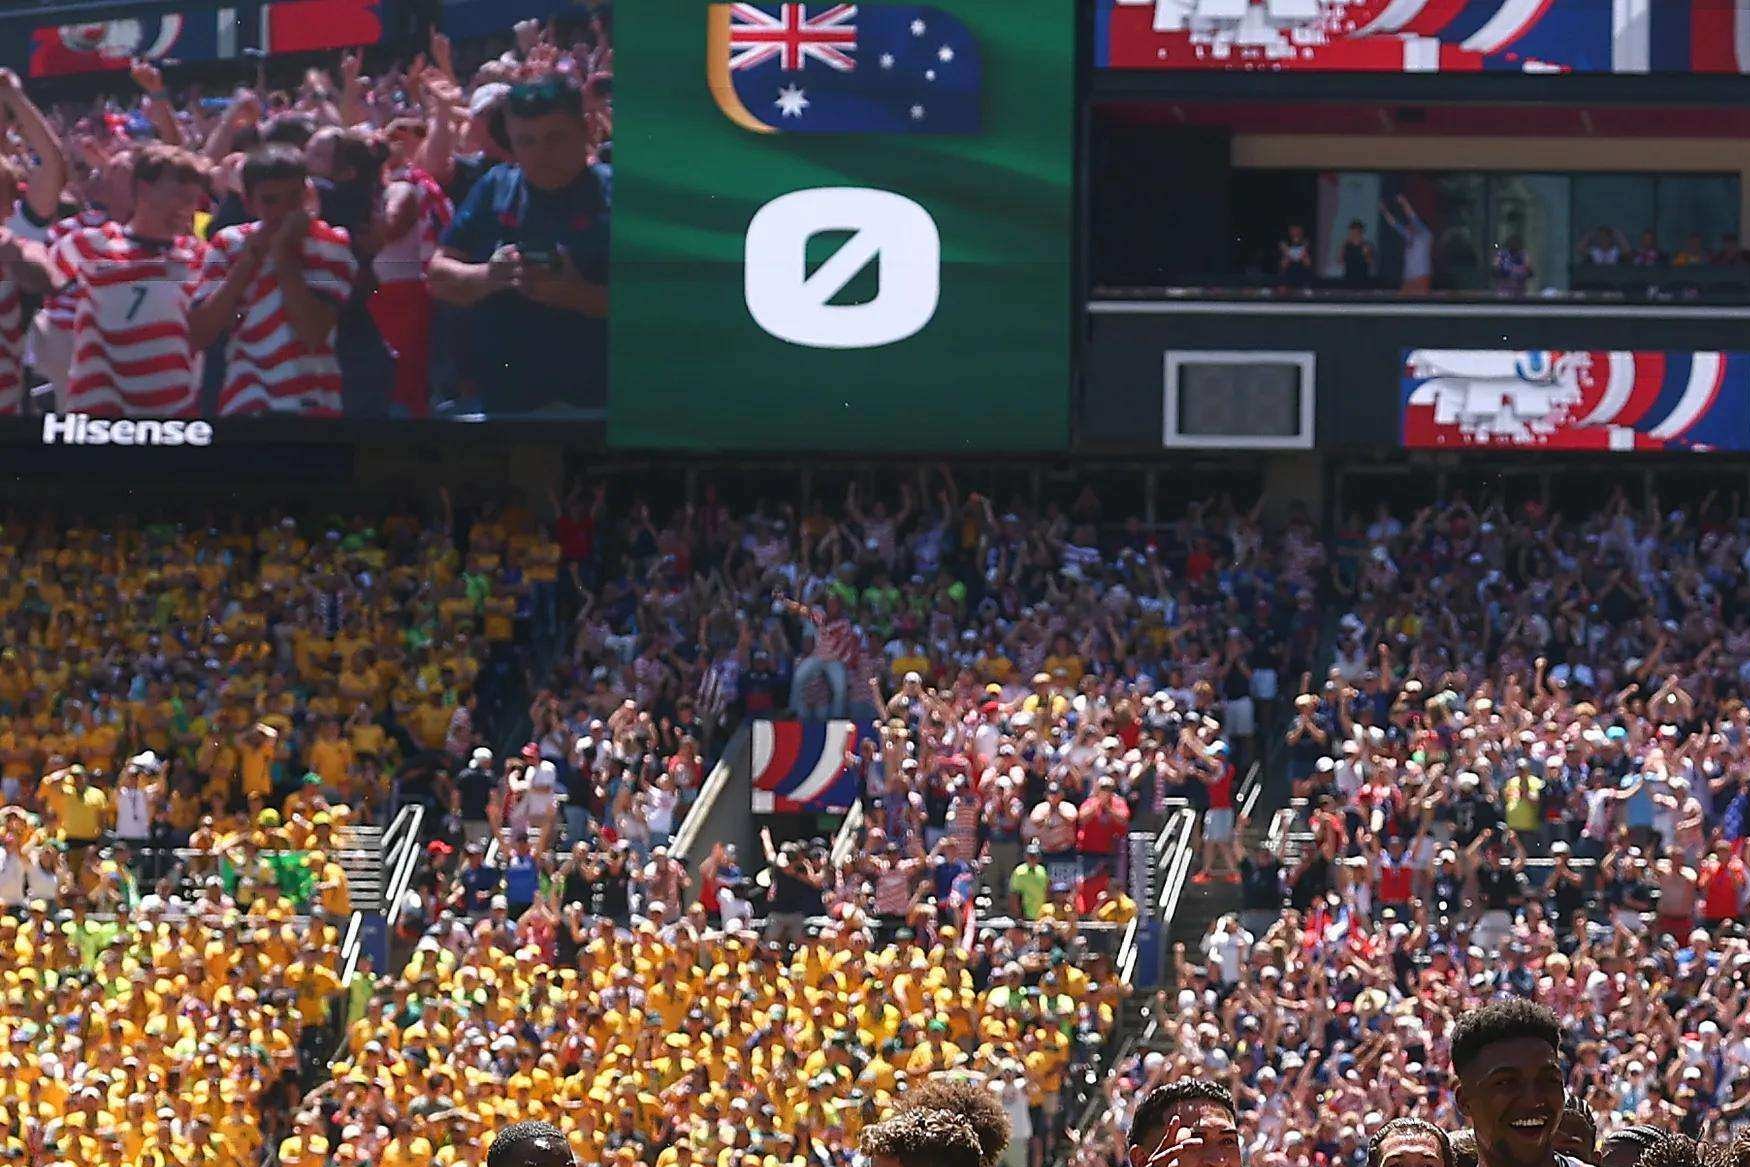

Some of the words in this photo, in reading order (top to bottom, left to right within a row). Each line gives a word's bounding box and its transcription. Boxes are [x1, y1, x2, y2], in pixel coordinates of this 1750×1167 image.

[745, 186, 940, 350] 0
[125, 286, 148, 320] 7
[42, 412, 213, 446] Hisense
